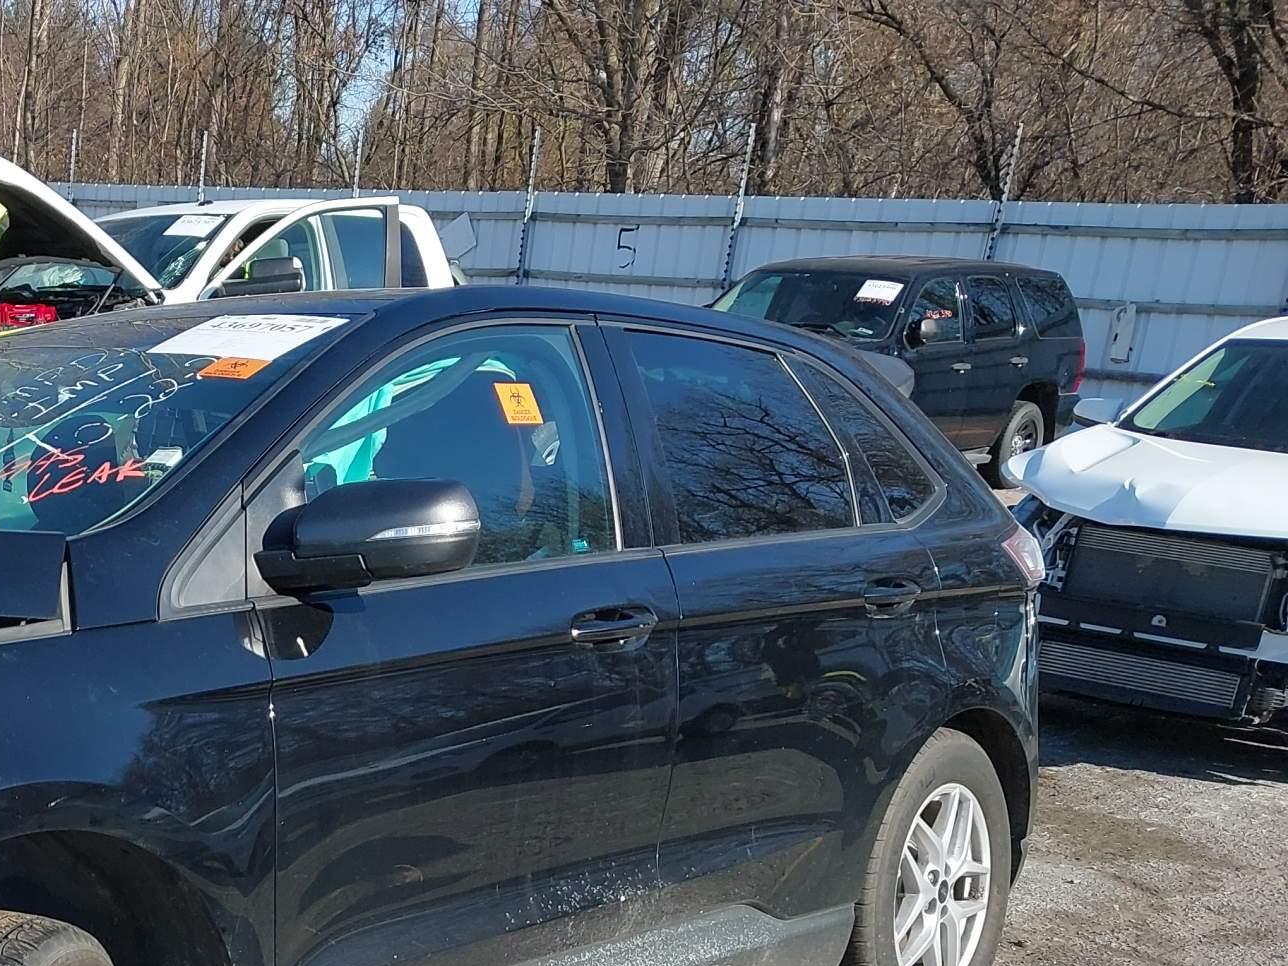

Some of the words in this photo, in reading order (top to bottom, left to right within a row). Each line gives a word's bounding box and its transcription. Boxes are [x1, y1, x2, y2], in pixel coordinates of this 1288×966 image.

[617, 224, 640, 269] 5
[210, 321, 314, 335] 43697057
[29, 459, 146, 502] LEAK
